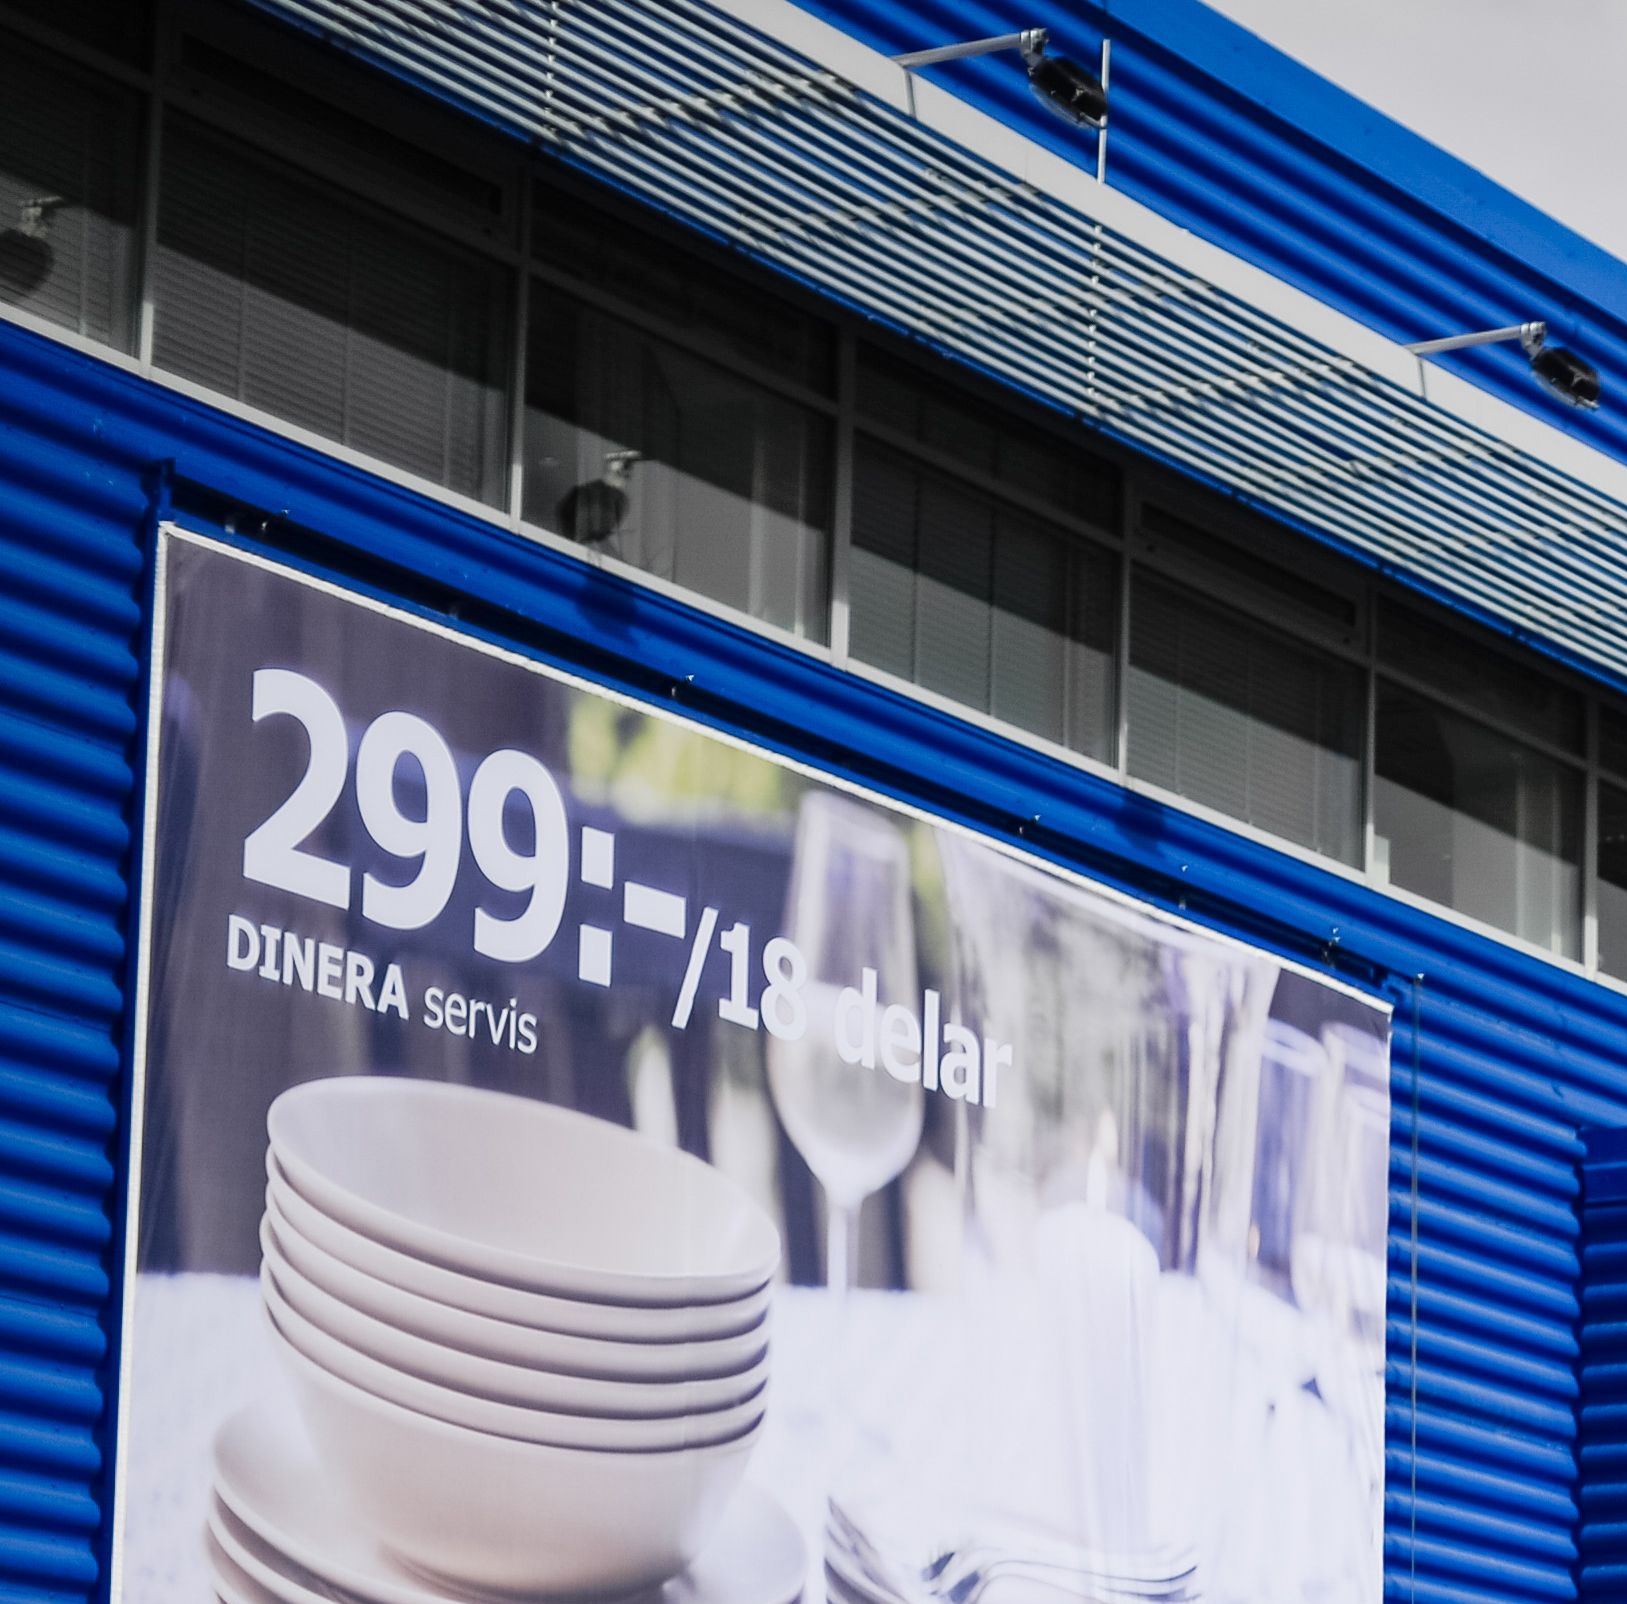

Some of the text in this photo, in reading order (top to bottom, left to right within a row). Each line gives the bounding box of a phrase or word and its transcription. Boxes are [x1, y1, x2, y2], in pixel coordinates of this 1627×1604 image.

[227, 914, 538, 1055] DINERA servis
[835, 967, 1013, 1109] delar
